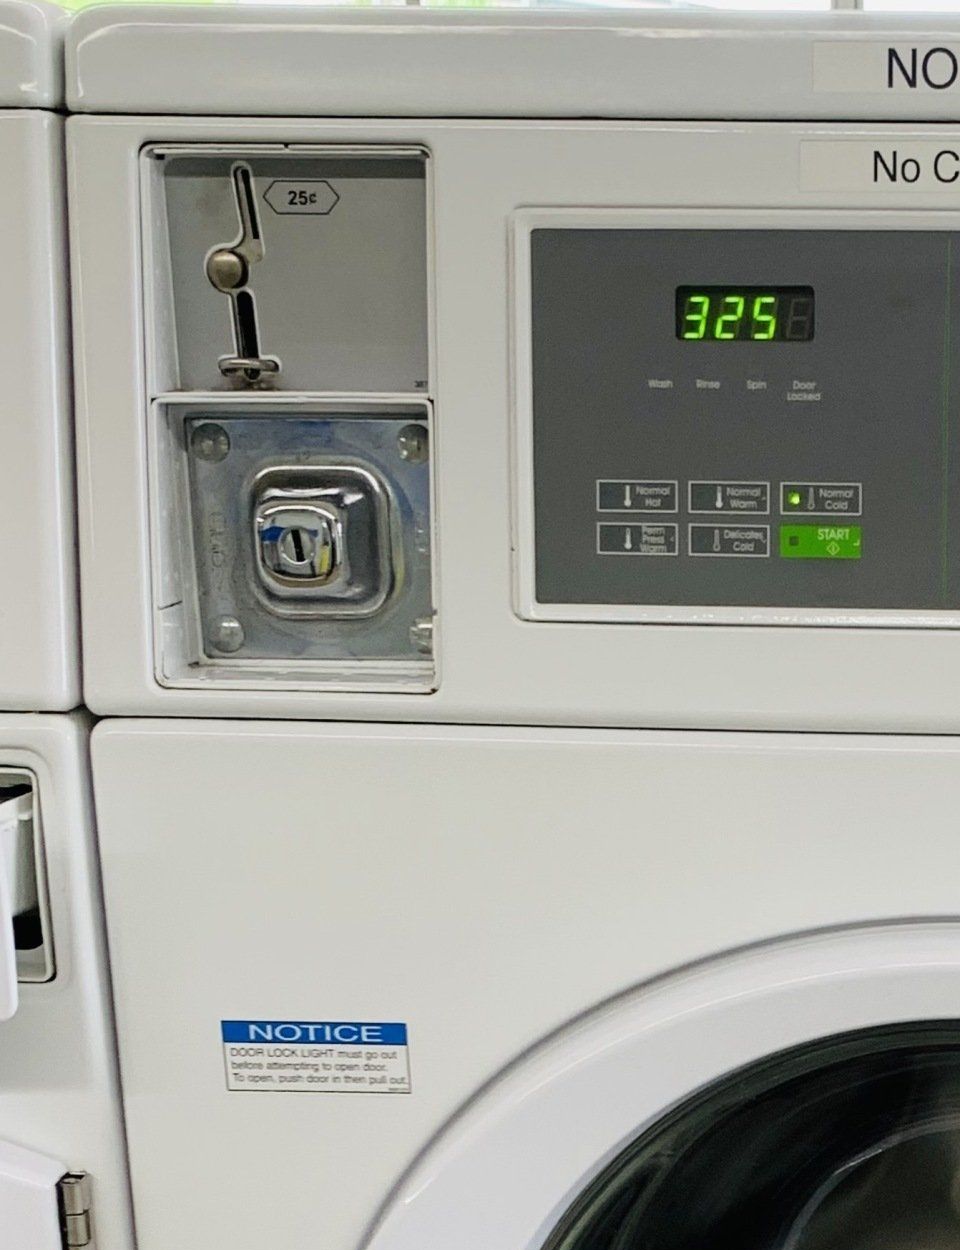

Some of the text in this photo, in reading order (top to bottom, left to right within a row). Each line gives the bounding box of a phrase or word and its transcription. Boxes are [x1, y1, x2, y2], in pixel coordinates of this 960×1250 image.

[887, 47, 959, 89] NO
[873, 151, 921, 183] No
[684, 296, 776, 339] 325
[648, 380, 673, 388] Wash
[696, 380, 720, 389] Rinse
[747, 380, 767, 390] Spin
[793, 381, 817, 390] Door
[787, 392, 821, 401] Locked
[636, 486, 670, 496] Normal
[726, 487, 761, 497] Normal
[819, 489, 854, 498] Normal
[645, 498, 661, 507] Hot
[730, 500, 757, 509] Warm
[825, 500, 848, 510] Cold
[817, 528, 850, 540] START
[733, 541, 754, 551] Cold
[249, 1024, 383, 1042] NOTICE
[231, 1048, 263, 1057] DOOR
[268, 1048, 298, 1058] LOCK
[302, 1049, 335, 1058] LIGHT
[338, 1051, 362, 1059] must
[366, 1052, 378, 1061] go
[232, 1062, 263, 1070] before
[267, 1063, 319, 1072] attempting
[322, 1063, 332, 1071] to
[335, 1065, 360, 1073] open
[233, 1073, 245, 1082] To
[307, 1075, 329, 1083] door
[344, 1075, 367, 1083] then
[369, 1076, 387, 1085] pull
